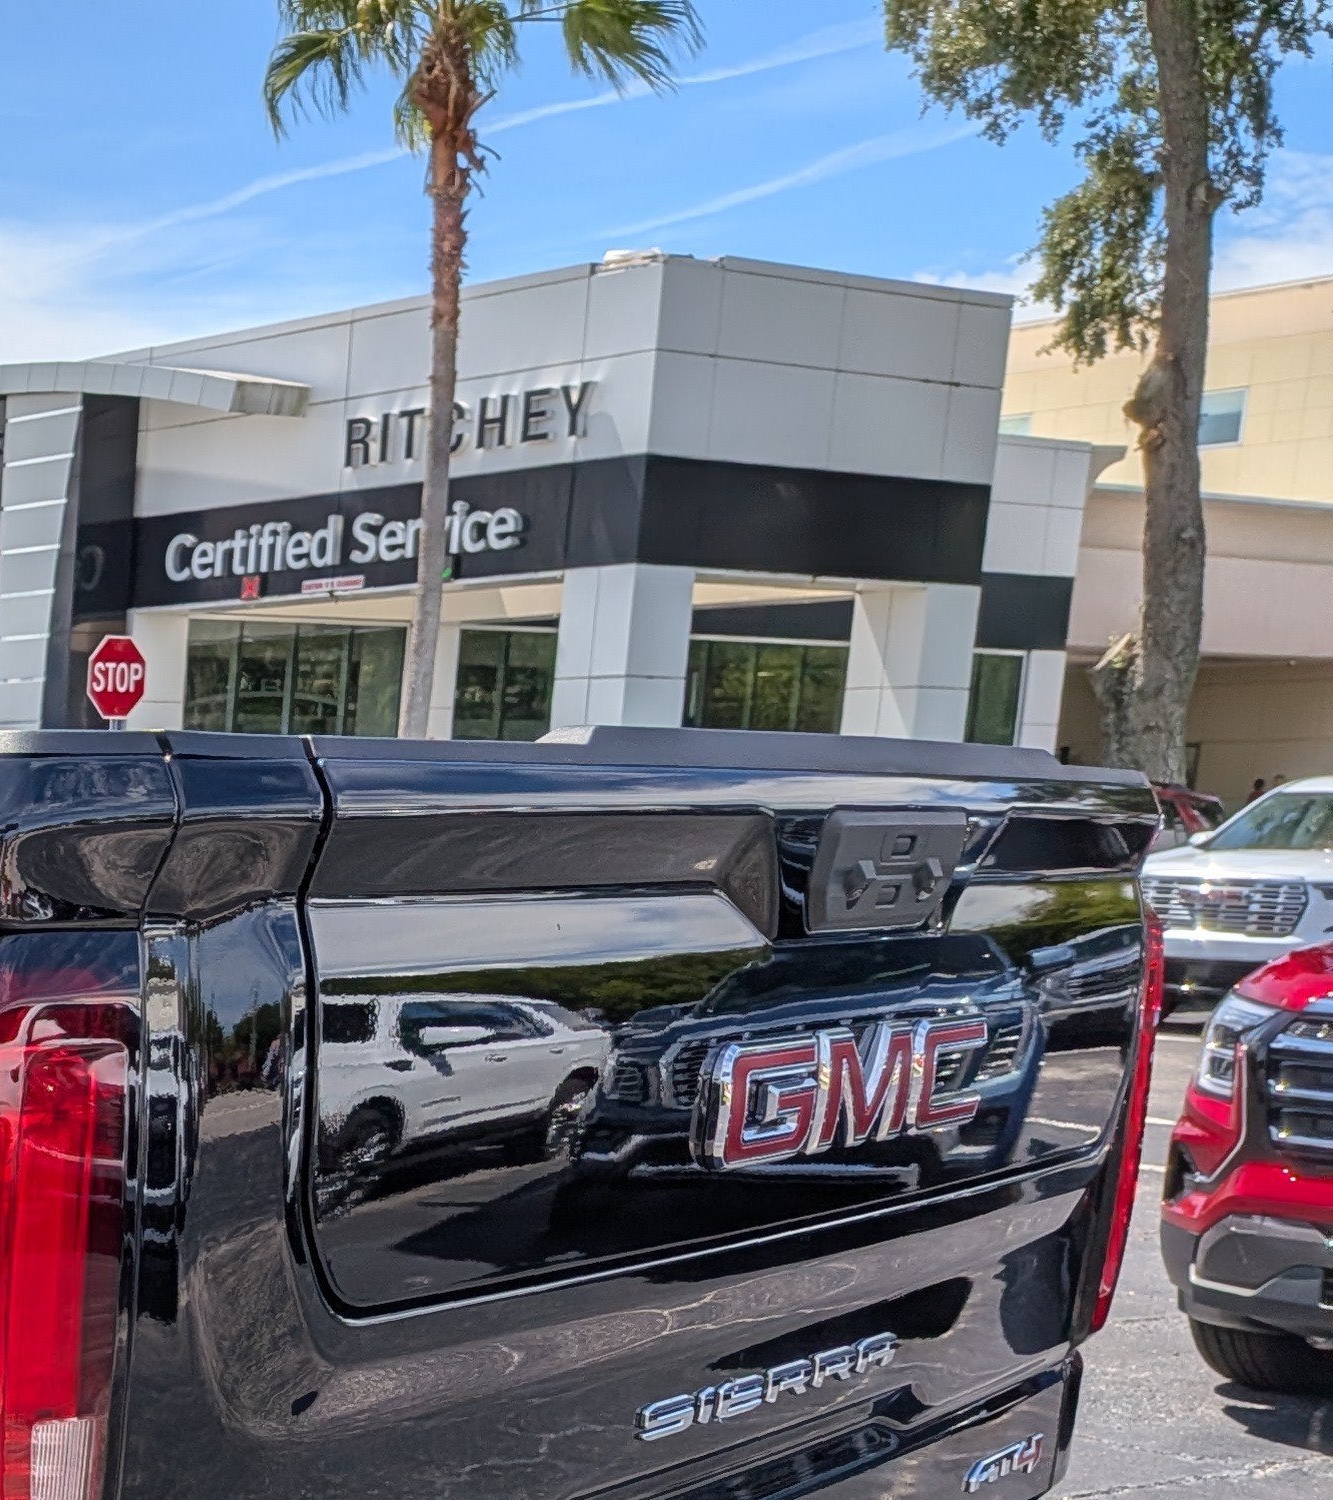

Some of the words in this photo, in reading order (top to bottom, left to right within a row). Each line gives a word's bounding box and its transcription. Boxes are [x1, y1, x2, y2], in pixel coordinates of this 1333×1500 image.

[165, 514, 344, 583] Certified
[349, 500, 523, 565] Serice
[92, 661, 143, 693] STOP
[697, 1013, 989, 1171] GMC
[634, 1331, 898, 1441] SIERRA
[960, 1432, 1044, 1493] AT4
